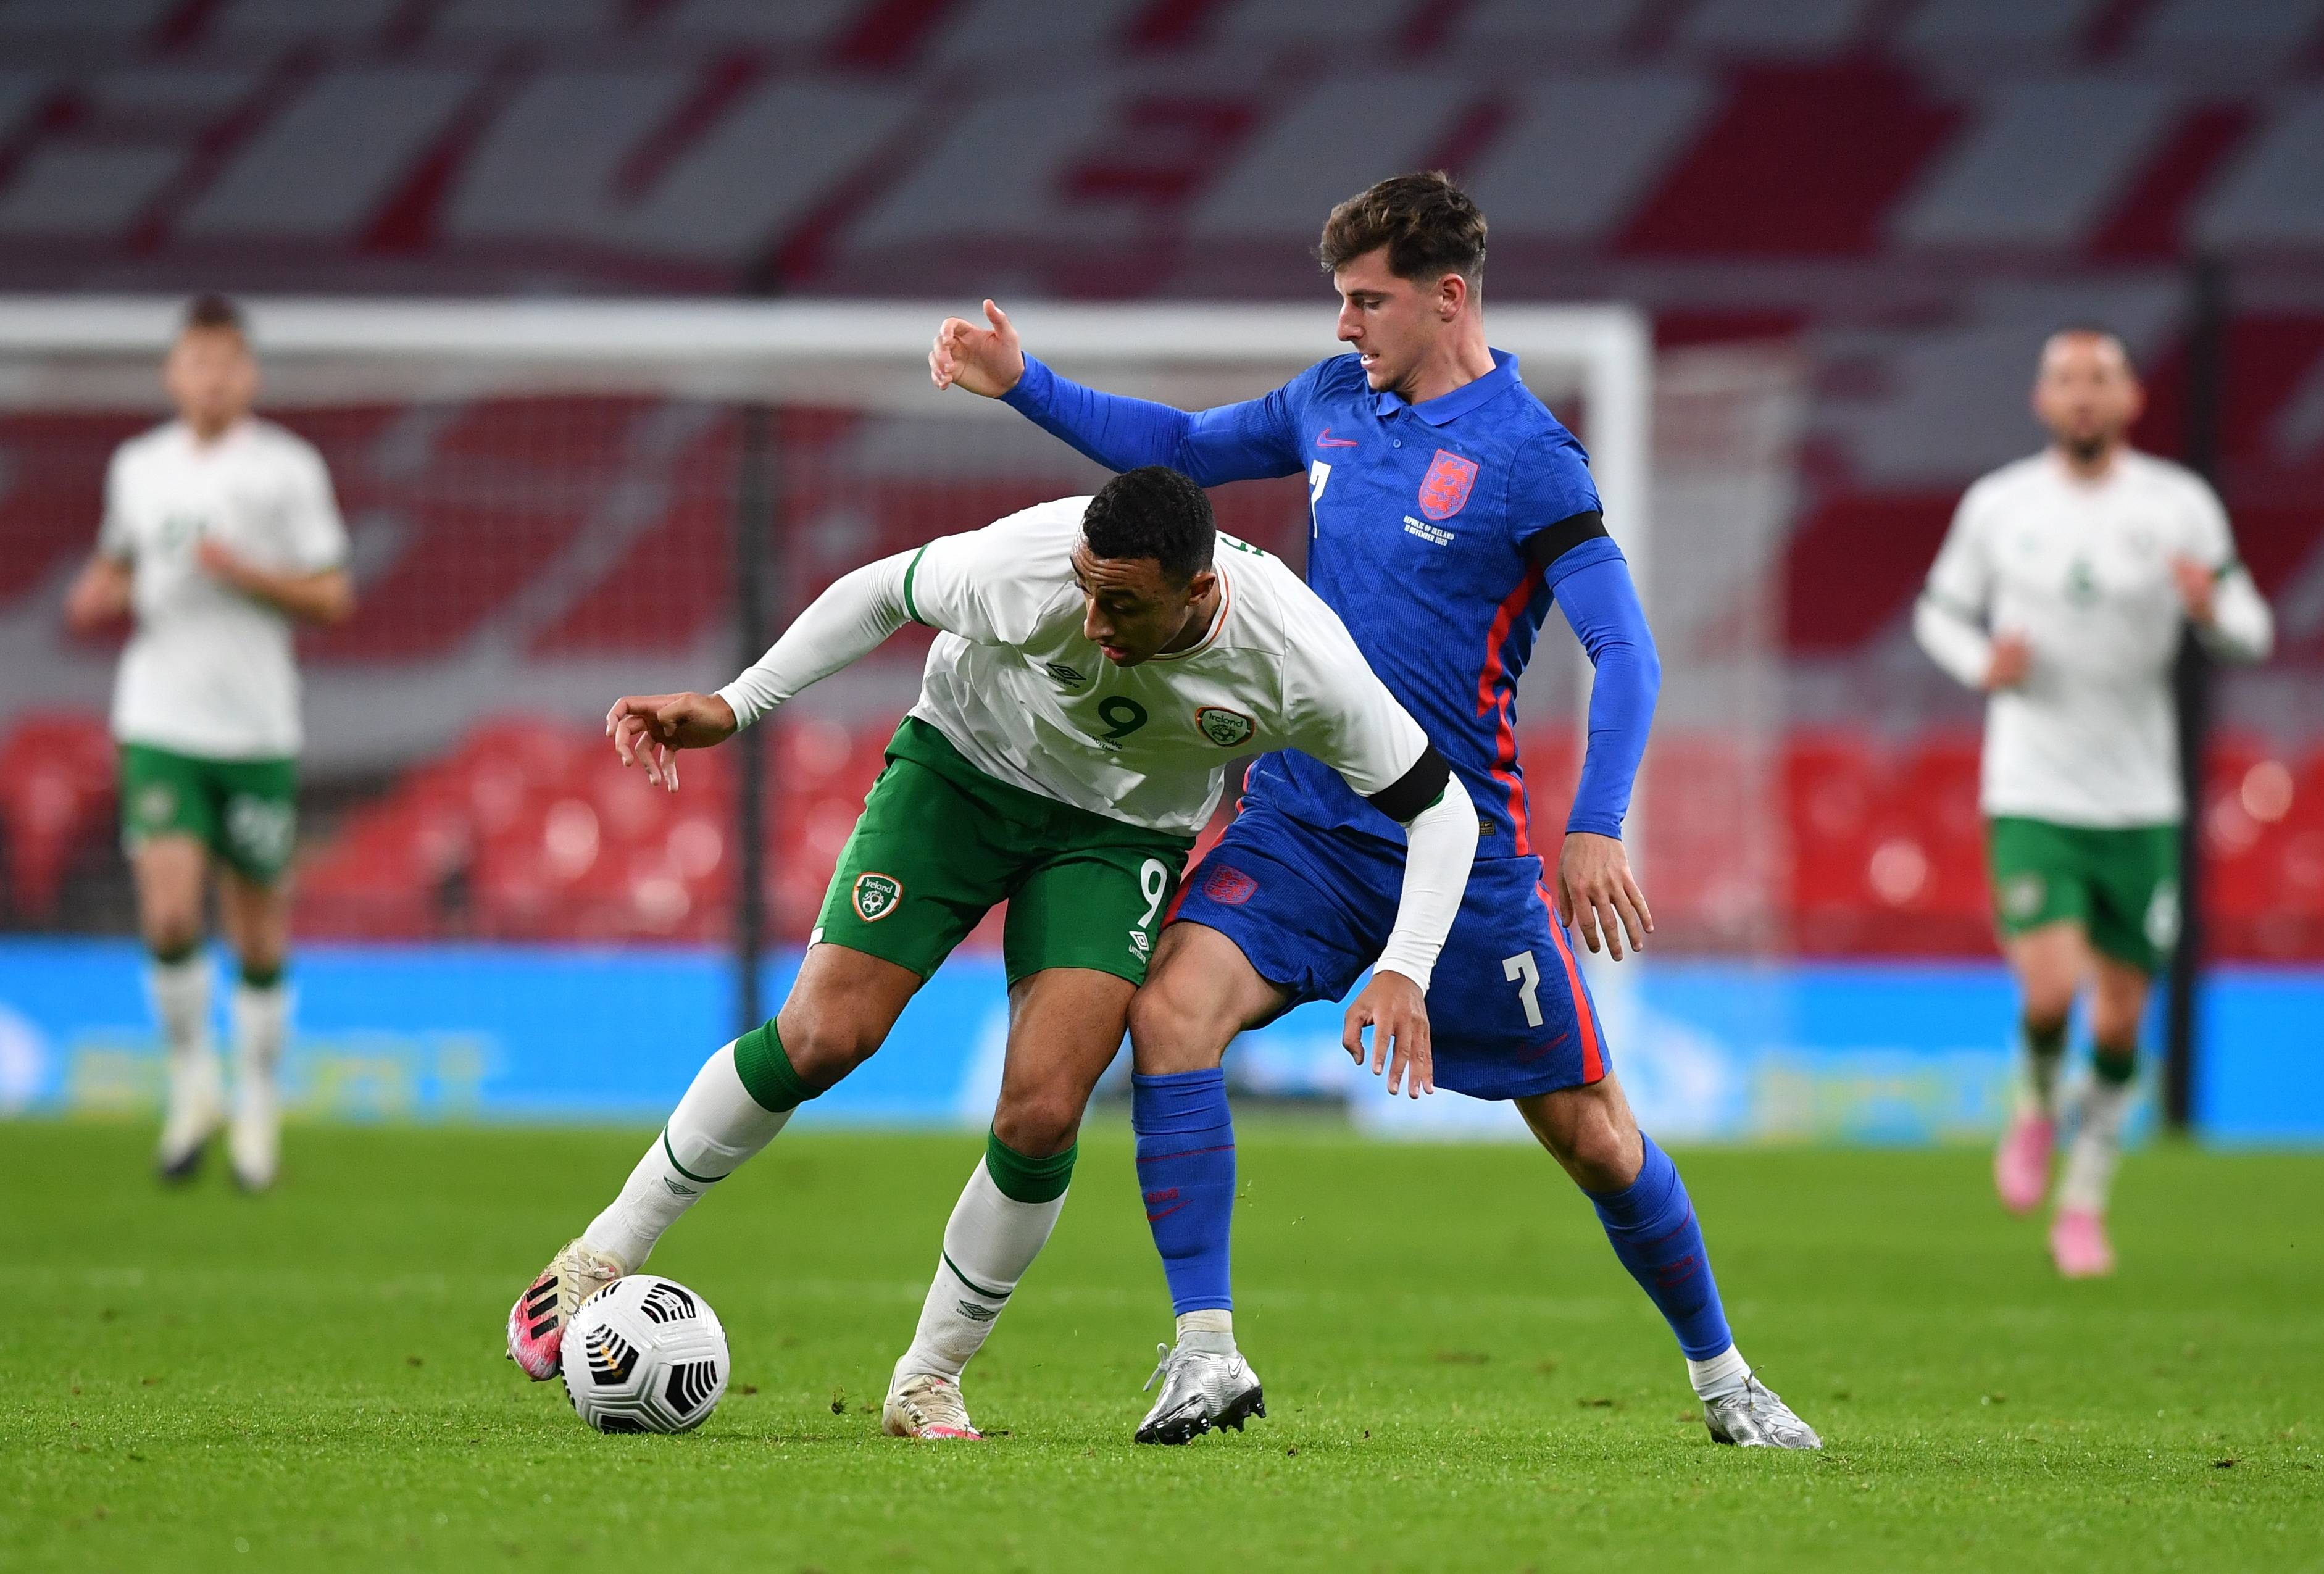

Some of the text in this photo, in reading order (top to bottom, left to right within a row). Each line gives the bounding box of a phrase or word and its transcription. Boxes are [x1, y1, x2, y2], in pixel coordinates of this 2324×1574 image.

[1309, 459, 1332, 539] 7
[1403, 515, 1455, 541] REPUBLIC OF IRELAND
[1409, 526, 1435, 542] NOVEMBER
[1435, 536, 1448, 546] 2020
[1098, 696, 1148, 739] 9
[1209, 712, 1243, 727] Ireland
[865, 878, 893, 894] Ireland
[1137, 858, 1168, 929] 9
[1502, 949, 1544, 1028] 7
